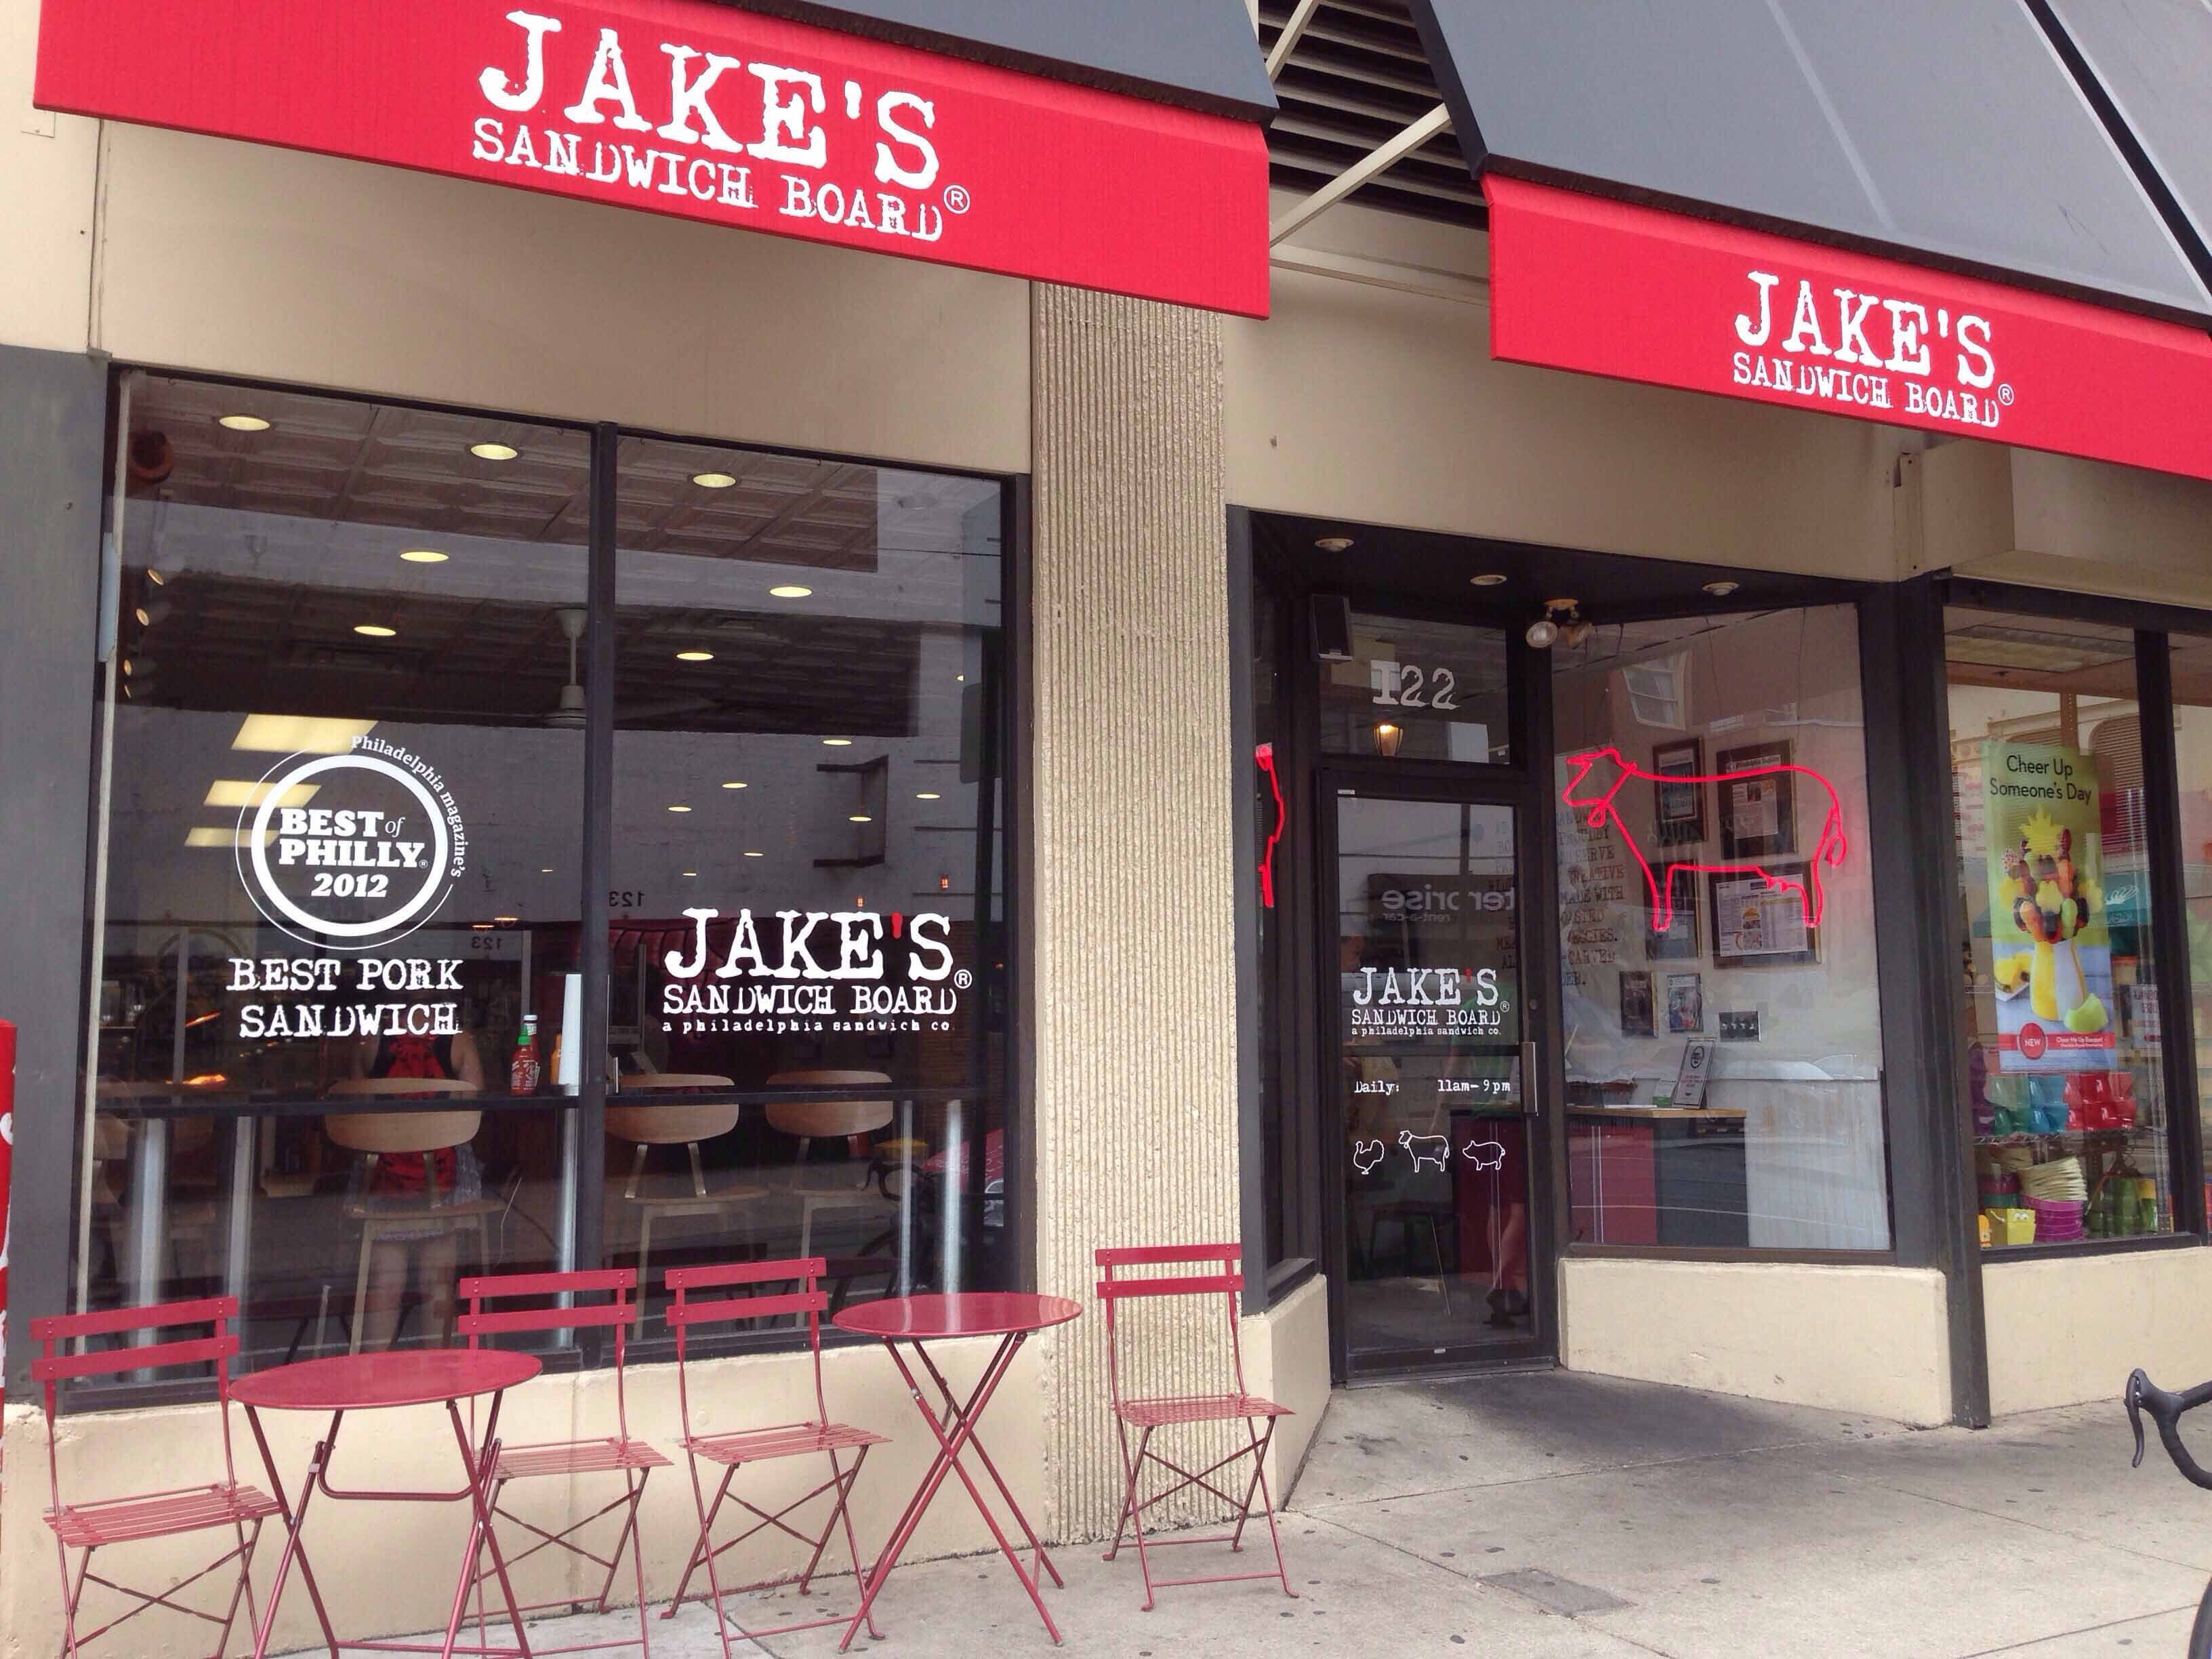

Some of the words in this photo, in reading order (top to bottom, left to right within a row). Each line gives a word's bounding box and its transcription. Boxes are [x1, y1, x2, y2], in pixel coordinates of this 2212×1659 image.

[478, 10, 939, 190] JAKE'S
[473, 117, 758, 209] SANDWICH
[1734, 270, 1995, 389] JAKE'S
[1732, 352, 1894, 409] SANDWICH
[1372, 661, 1461, 710] 122
[2006, 754, 2049, 774] Cheer
[2053, 758, 2073, 780] Up
[351, 735, 445, 793] Philadelphia
[440, 791, 469, 878] magazine's
[1990, 777, 2063, 799] Someone's
[2066, 782, 2092, 805] Day
[280, 808, 384, 838] BEST
[385, 817, 406, 838] of
[310, 873, 389, 898] 2012
[663, 907, 954, 981] JAKE'S
[226, 958, 341, 991] BEST
[356, 958, 464, 991] PORK
[1353, 966, 1498, 1006] JAKE'S
[663, 985, 836, 1015] SANDWICH
[239, 1003, 463, 1038] SANDWICH
[662, 1021, 672, 1032] a
[682, 1019, 823, 1035] philadelphia
[833, 1019, 920, 1032] sandwich
[1351, 1009, 1439, 1026] SANDWICH
[1351, 1027, 1358, 1036] a
[1361, 1026, 1434, 1037] philadelphia
[1437, 1026, 1484, 1036] sandwich
[1354, 1080, 1399, 1096] Daily:
